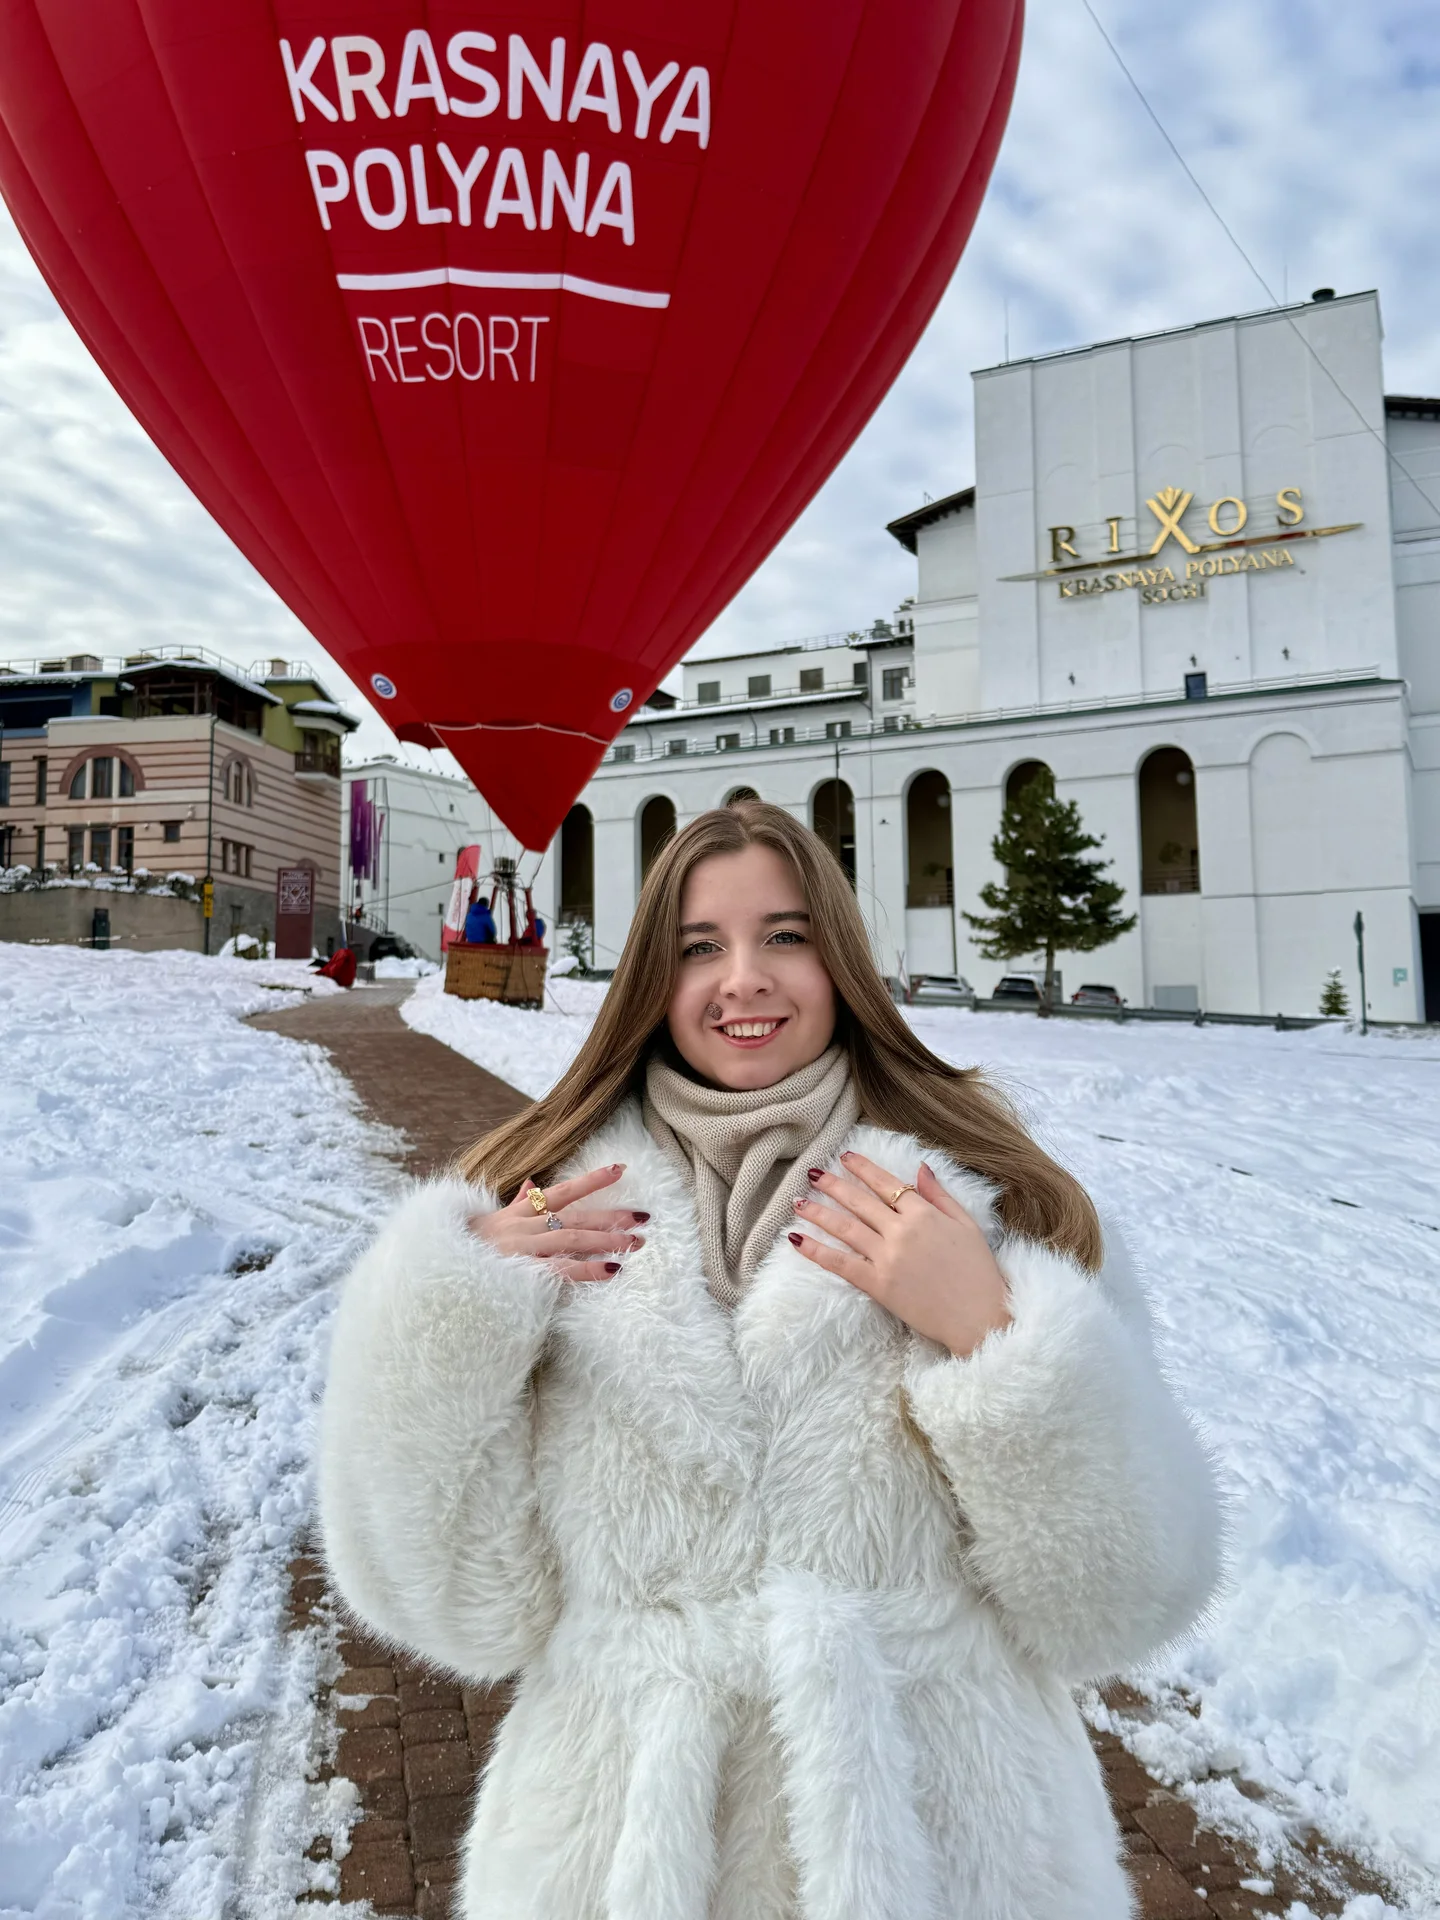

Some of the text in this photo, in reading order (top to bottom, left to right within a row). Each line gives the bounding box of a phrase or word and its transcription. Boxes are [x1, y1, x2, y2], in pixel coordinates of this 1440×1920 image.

[279, 29, 711, 150] KRASNAYA
[305, 142, 636, 246] POLYANA
[357, 312, 550, 383] RESORT
[1048, 486, 1306, 564] RIXOS
[1058, 548, 1295, 600] KRASNAYA POLYANA
[1141, 581, 1207, 606] SOCHI
